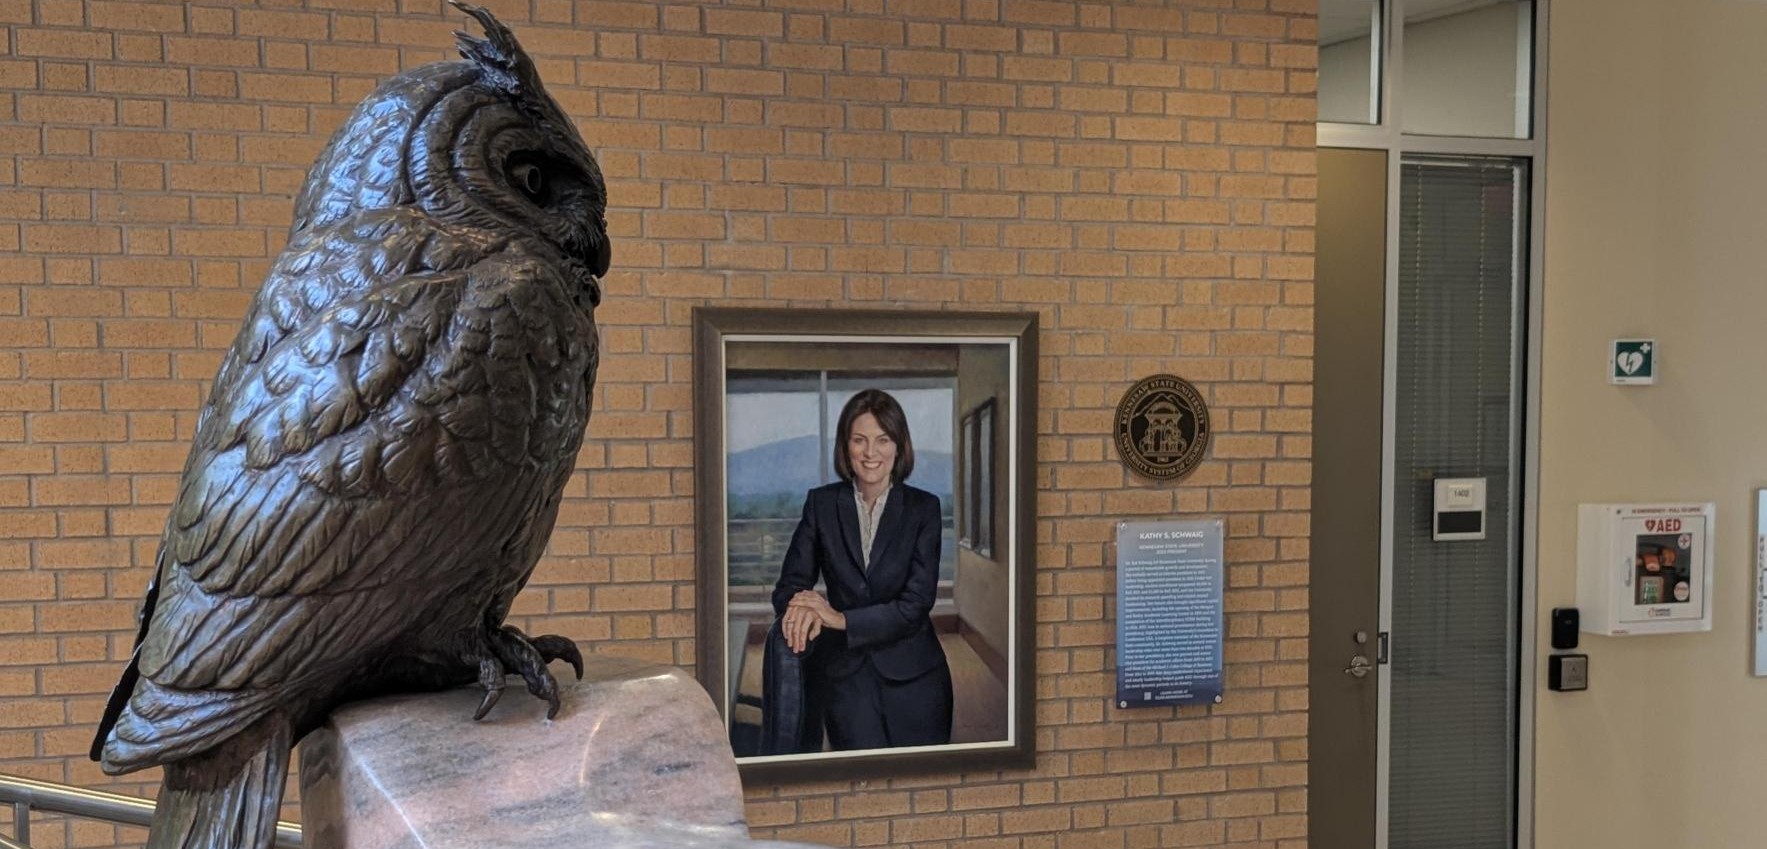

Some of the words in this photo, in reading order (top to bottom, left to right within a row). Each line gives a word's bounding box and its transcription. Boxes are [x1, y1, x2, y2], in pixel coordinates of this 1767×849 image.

[1121, 384, 1149, 425] KENNESAW
[1150, 380, 1174, 390] STATE
[1175, 382, 1205, 425] UNIVERSITY
[1120, 432, 1148, 472] UNIVERSITY
[1149, 467, 1176, 476] SYSTEM
[1185, 432, 1205, 465] GEORGIA
[1139, 532, 1162, 540] KATHY
[1172, 531, 1204, 539] SCHWAIG
[1656, 519, 1681, 532] AED
